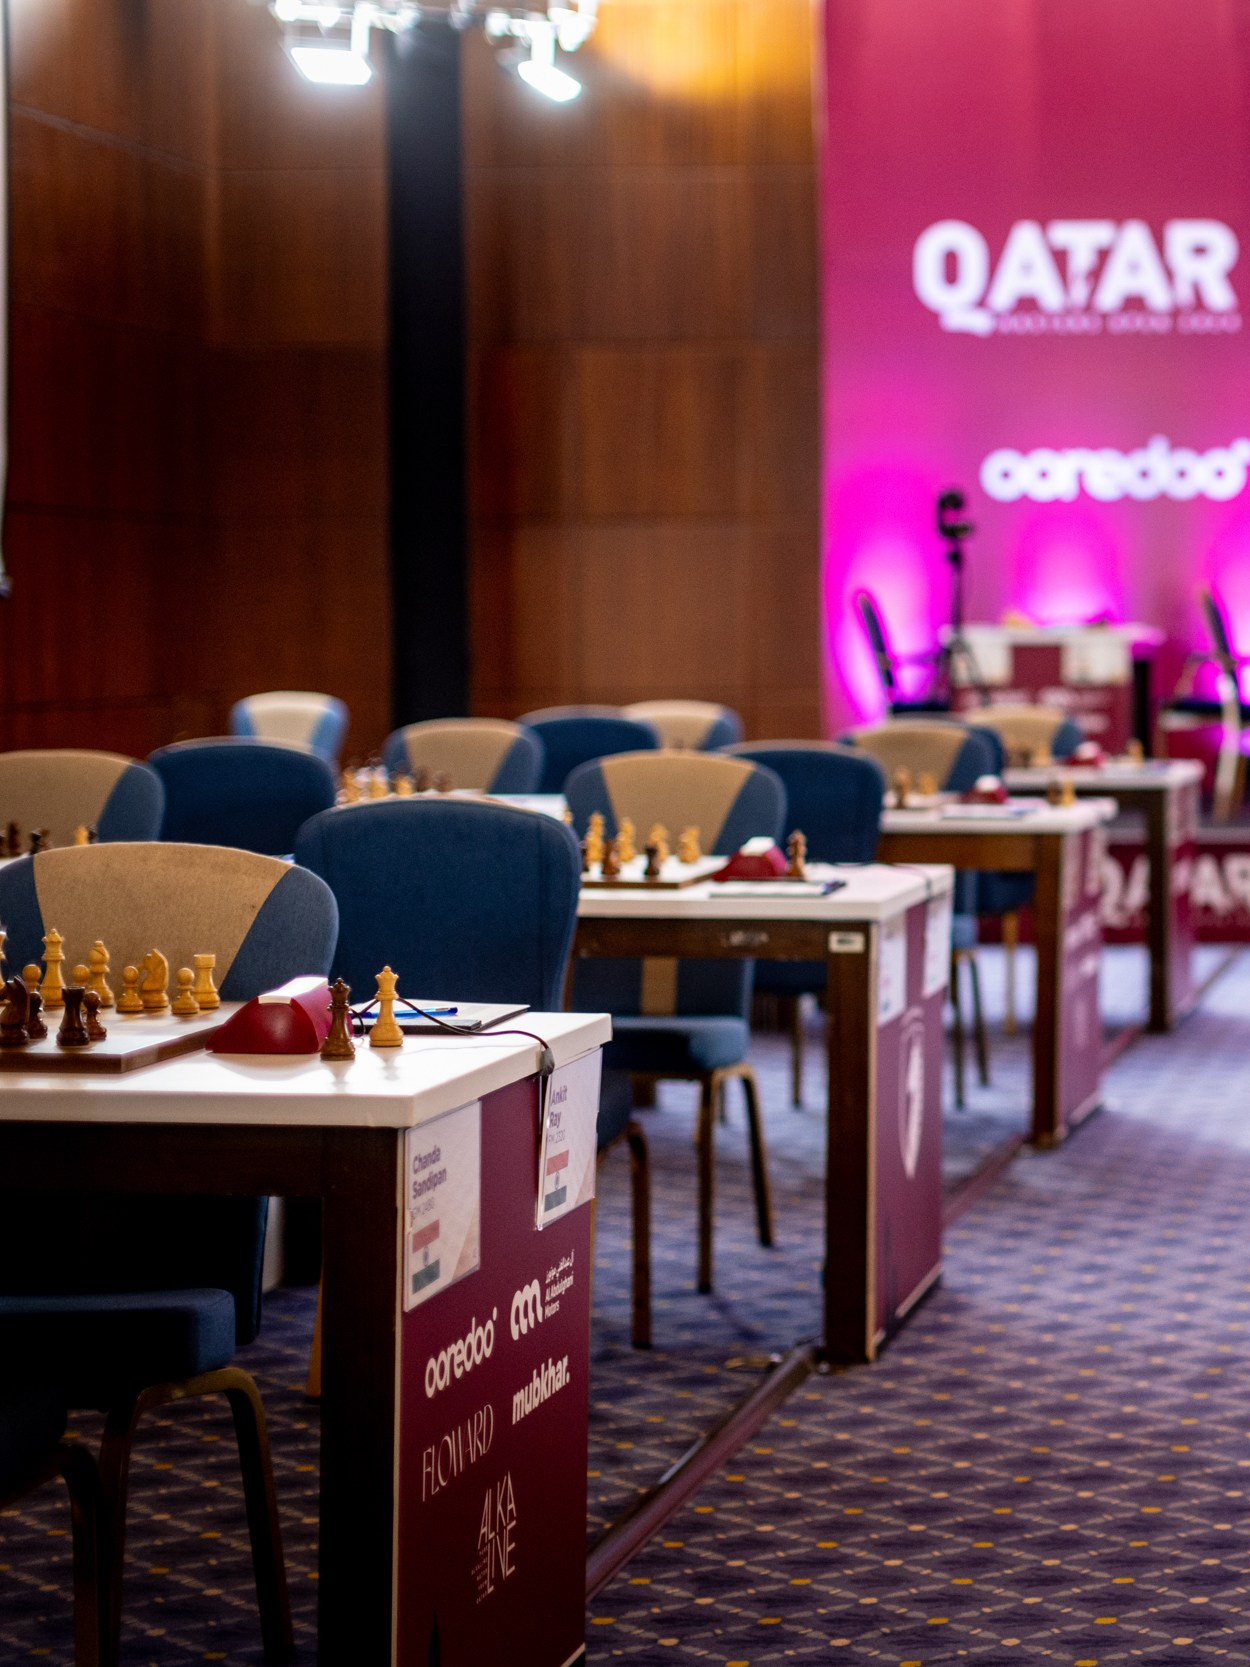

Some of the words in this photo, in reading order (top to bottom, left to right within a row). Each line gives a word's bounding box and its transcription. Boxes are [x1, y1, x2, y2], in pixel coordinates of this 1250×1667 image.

[914, 220, 1239, 335] QATAR
[551, 1085, 567, 1107] Ankit
[549, 1112, 562, 1129] Ray
[413, 1145, 441, 1174] Chanda
[412, 1168, 447, 1200] Sandipan
